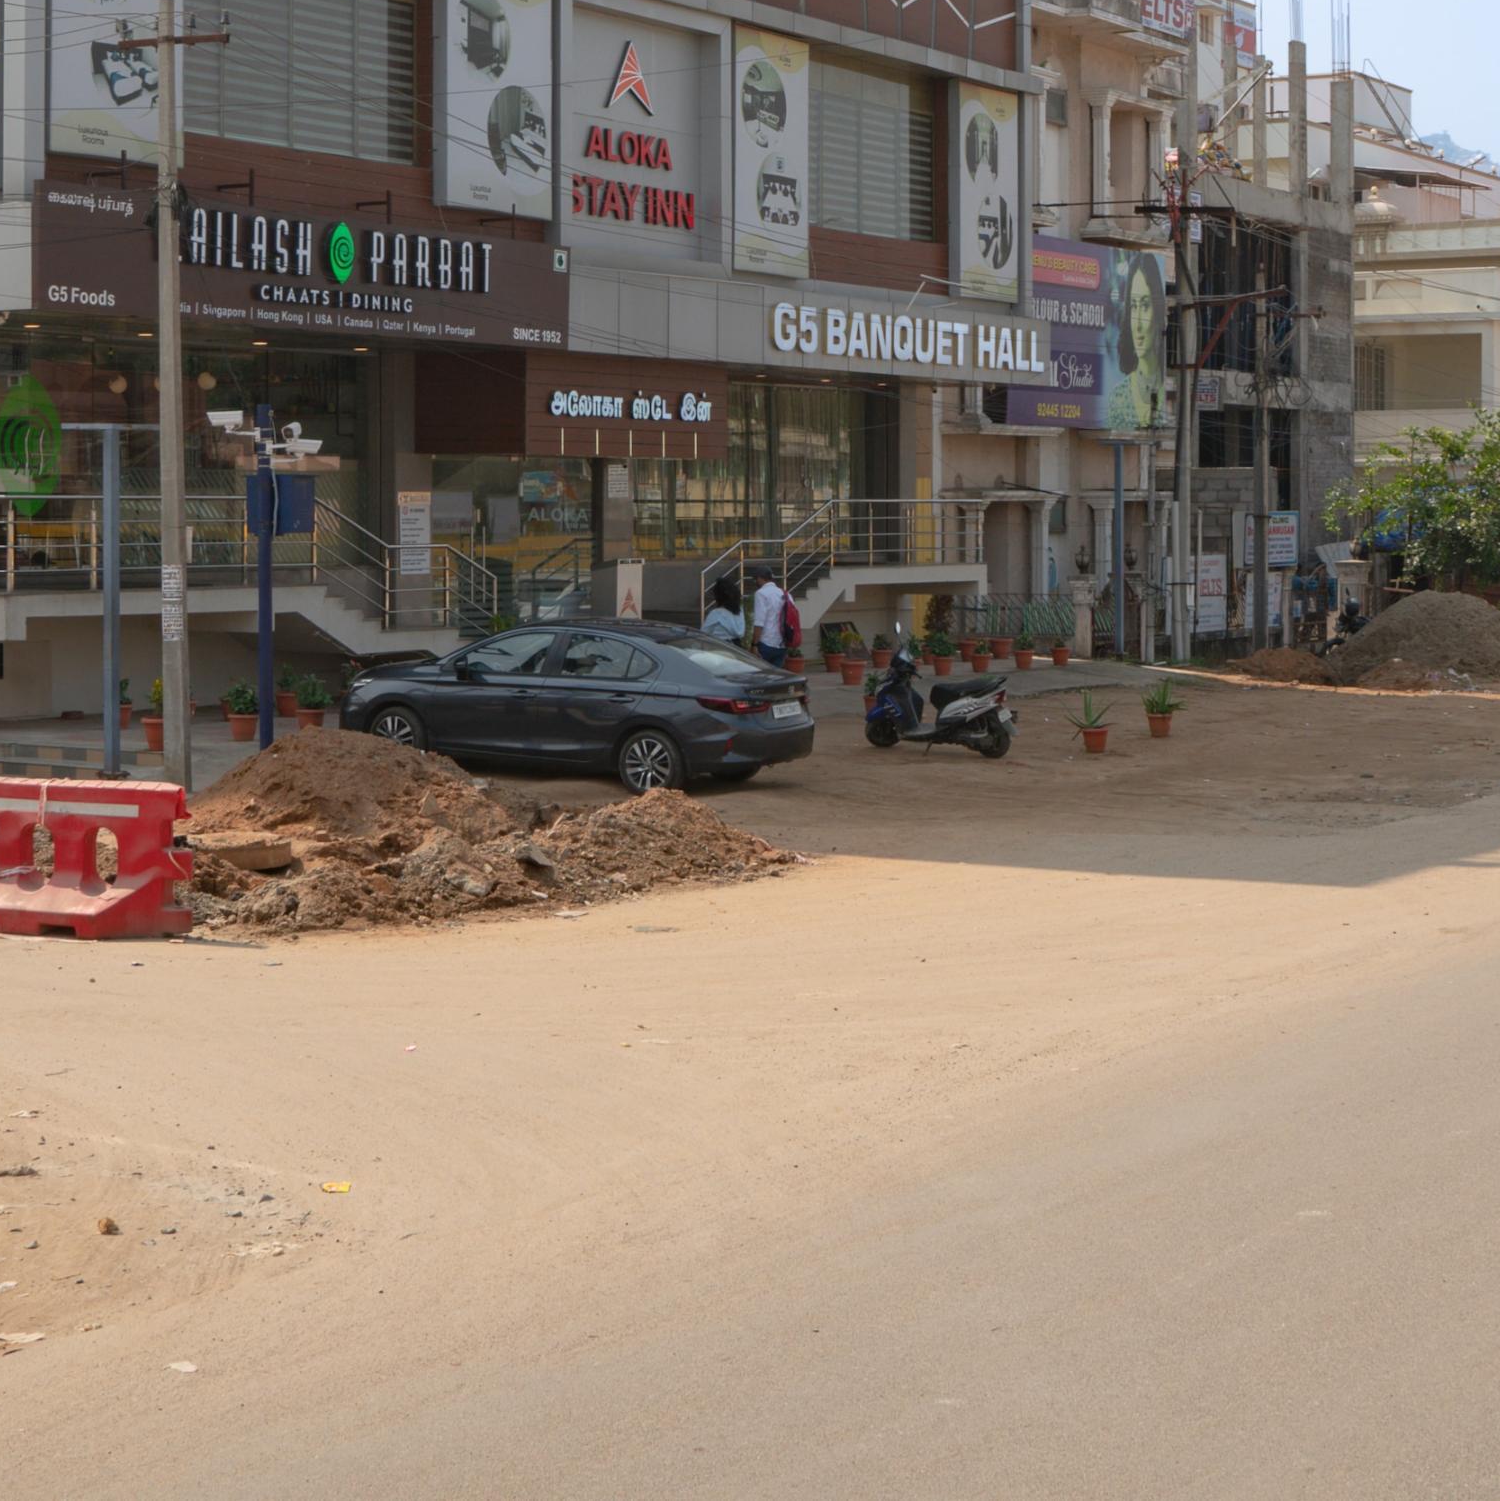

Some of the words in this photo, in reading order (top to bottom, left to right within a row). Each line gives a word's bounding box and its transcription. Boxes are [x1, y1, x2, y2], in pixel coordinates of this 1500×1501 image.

[78, 124, 109, 137] Luxurious
[82, 134, 105, 146] Rooms
[584, 125, 673, 171] ALOKA
[571, 173, 642, 222] STAY
[643, 185, 696, 230] INN
[177, 207, 313, 276] AILASH
[370, 231, 493, 293] PARBAT
[1053, 257, 1079, 274] BEAUTY
[1079, 260, 1098, 276] CARE
[48, 284, 69, 303] G5
[70, 286, 116, 307] Foods
[260, 284, 331, 306] CHAATS
[351, 292, 414, 314] DINING
[202, 302, 247, 319] Singapore
[257, 307, 280, 323] Hong
[281, 310, 304, 325] Kong
[315, 313, 333, 325] USA
[343, 315, 374, 329] Canada
[412, 321, 437, 336] Kenya
[444, 324, 476, 338] Portugal
[1060, 306, 1069, 323] &
[1069, 301, 1106, 328] SCHOOL
[512, 326, 541, 342] SINCE
[541, 329, 562, 344] 1952
[773, 302, 819, 354] G5
[825, 307, 970, 367] BANQUET
[975, 324, 1046, 373] HALL
[1058, 352, 1095, 390] Studio
[550, 390, 624, 418] அலோகா
[680, 392, 713, 422] இன்
[527, 506, 589, 522] ALOKA
